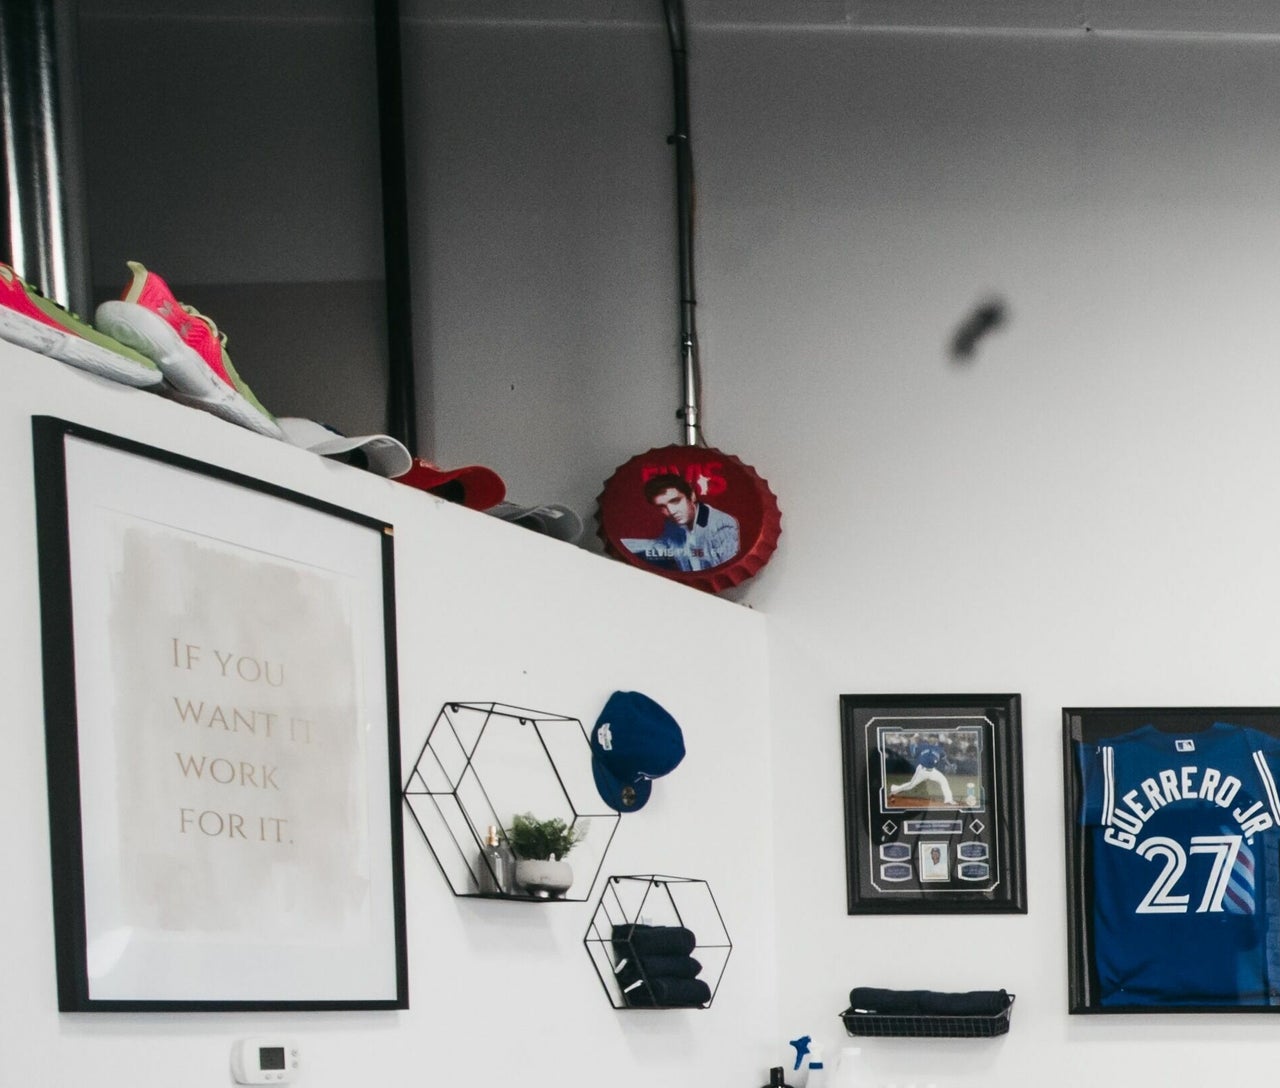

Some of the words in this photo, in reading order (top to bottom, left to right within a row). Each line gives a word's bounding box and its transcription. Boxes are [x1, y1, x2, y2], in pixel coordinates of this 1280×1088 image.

[213, 649, 285, 688] YOU
[172, 696, 279, 738] WANT
[175, 751, 280, 791] WORK
[179, 807, 248, 840] FOR
[259, 816, 294, 845] IT.
[1103, 766, 1242, 851] GUERRERO
[1232, 800, 1274, 846] JR.
[1135, 835, 1243, 914] 27
